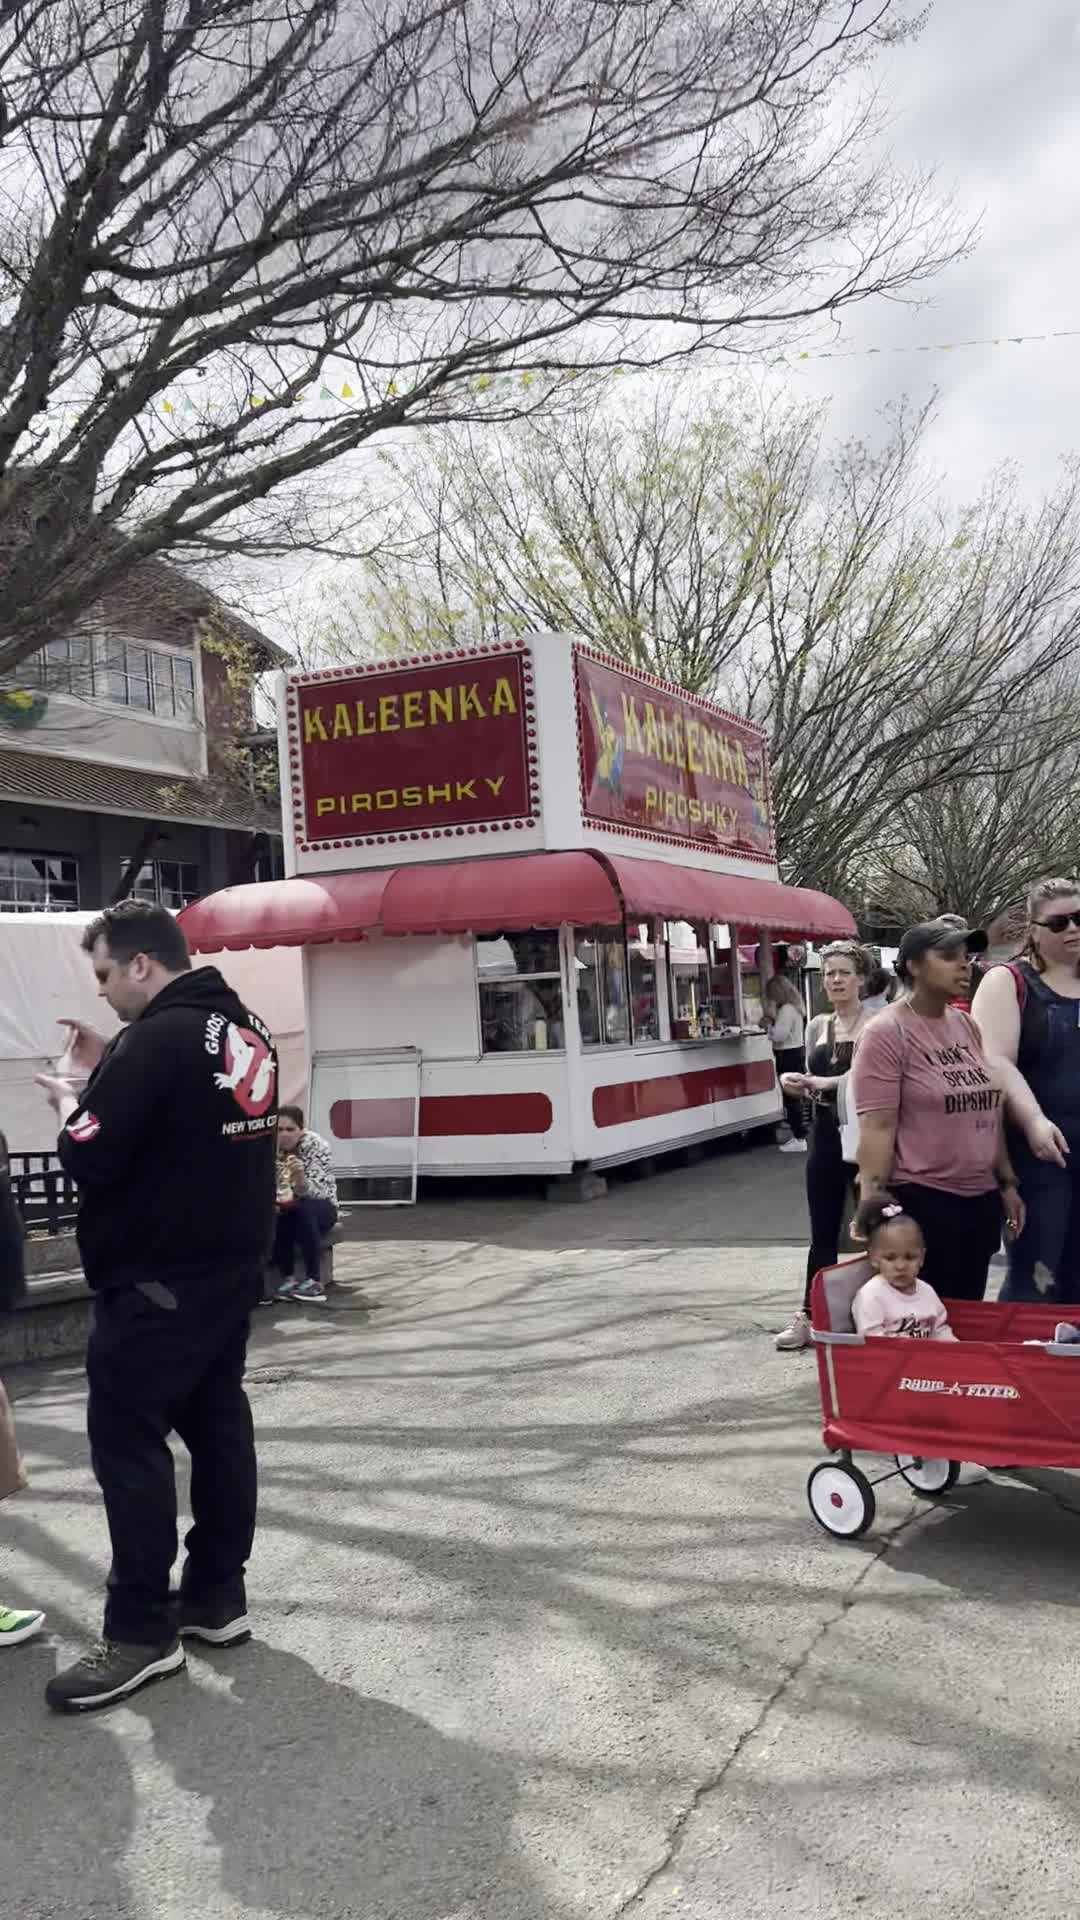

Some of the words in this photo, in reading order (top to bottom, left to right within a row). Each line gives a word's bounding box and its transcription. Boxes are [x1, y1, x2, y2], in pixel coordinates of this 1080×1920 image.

[303, 677, 518, 744] KALEENKA
[620, 691, 750, 788] KALEENKA
[316, 776, 506, 817] PIROSHKY
[645, 785, 739, 834] PIROSHKY
[923, 1053, 935, 1066] I
[936, 1042, 977, 1066] DON'T
[942, 1067, 991, 1088] SPEAK
[944, 1089, 1002, 1115] DIPSHIT
[222, 1121, 246, 1135] NEW
[247, 1118, 266, 1132] YORK
[898, 1377, 945, 1392] RADIO
[965, 1384, 1021, 1399] FLYER
